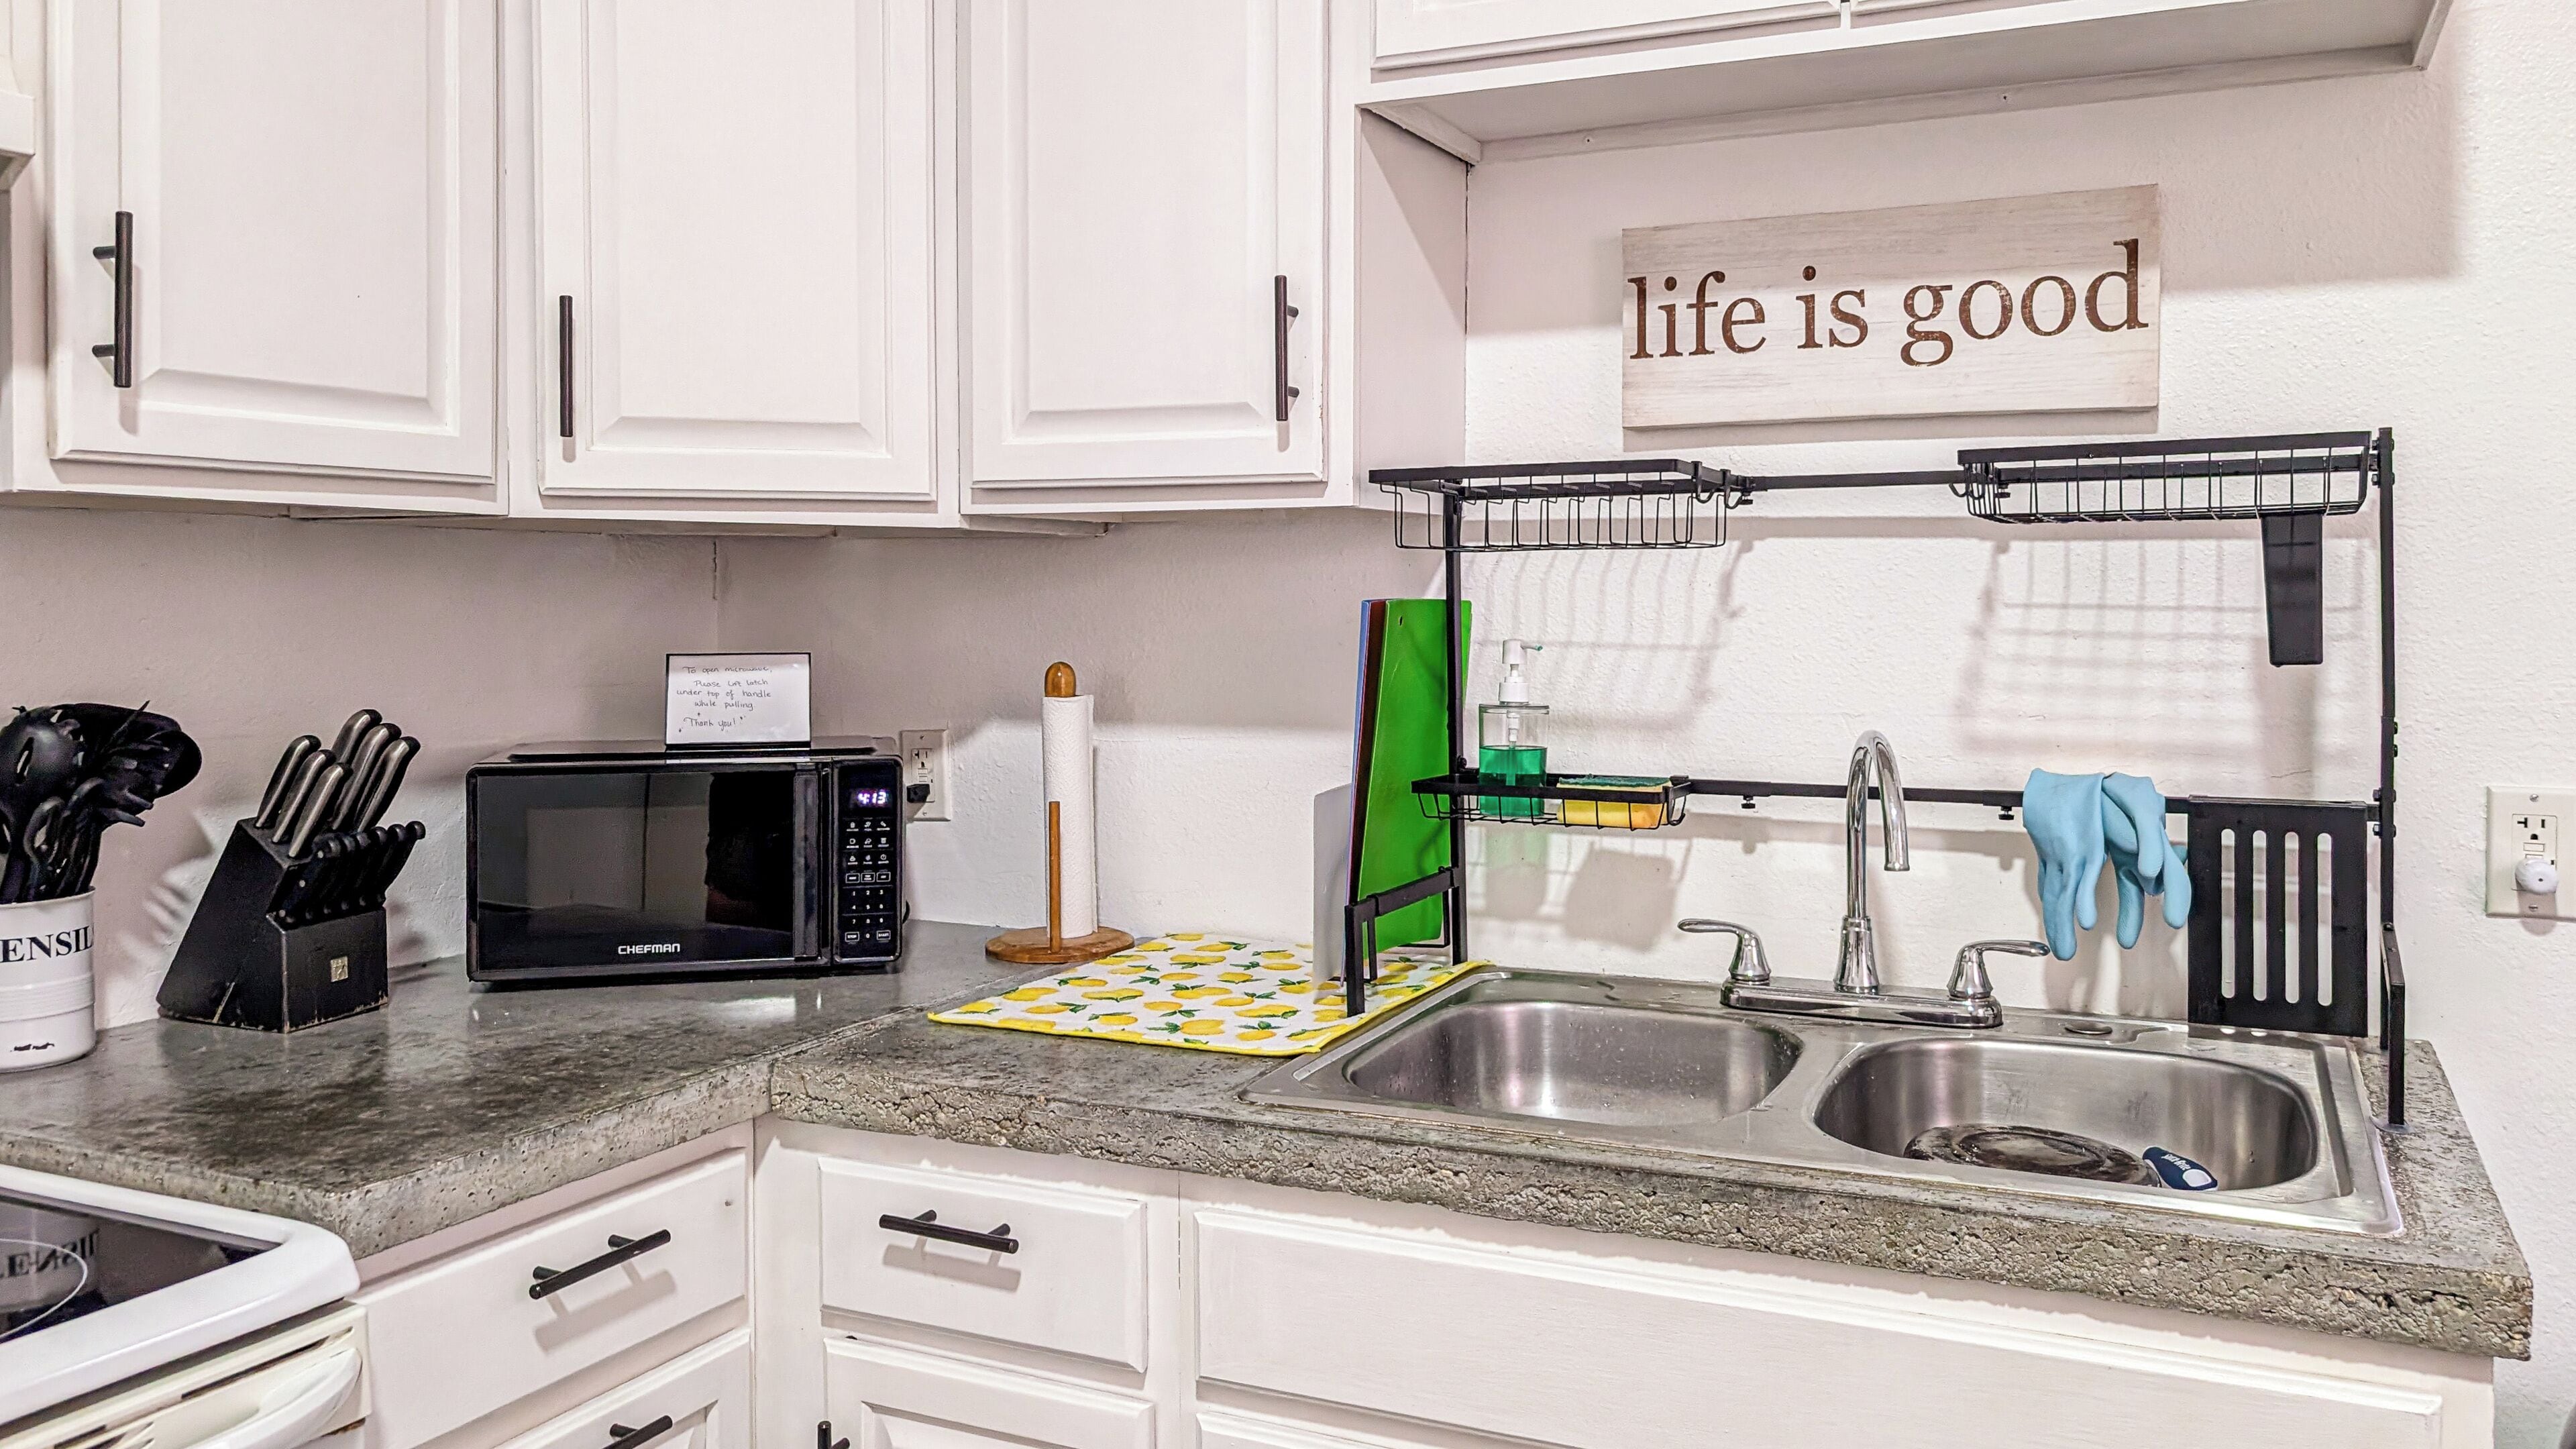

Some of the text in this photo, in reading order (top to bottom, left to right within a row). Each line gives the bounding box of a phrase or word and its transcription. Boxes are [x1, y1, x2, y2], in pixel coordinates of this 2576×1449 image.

[1627, 238, 2149, 367] life is good
[702, 666, 720, 675] open
[707, 690, 719, 699] top
[726, 690, 735, 700] of
[743, 690, 771, 698] handle
[724, 701, 753, 711] pulling
[683, 716, 714, 727] Thank
[858, 791, 887, 804] 4:13
[618, 943, 681, 955] CHEFMAN
